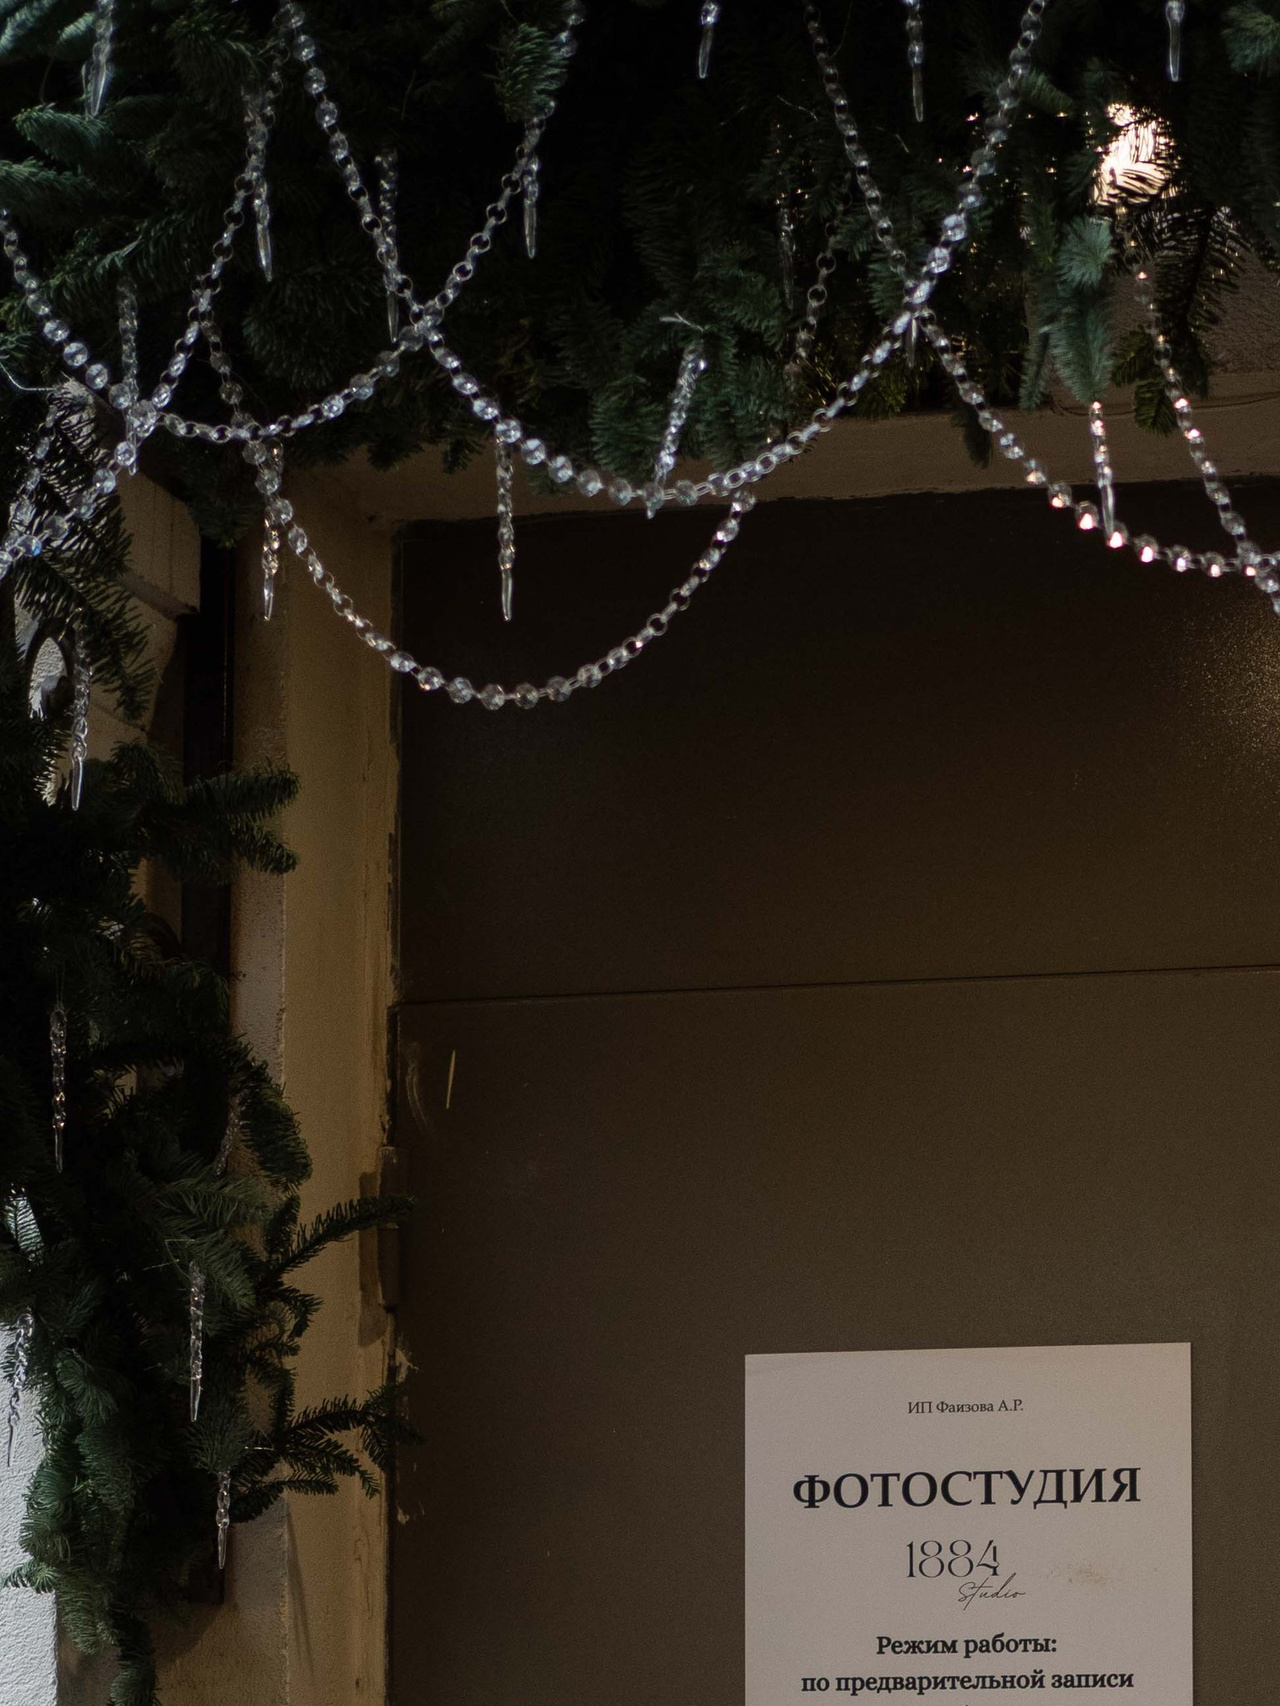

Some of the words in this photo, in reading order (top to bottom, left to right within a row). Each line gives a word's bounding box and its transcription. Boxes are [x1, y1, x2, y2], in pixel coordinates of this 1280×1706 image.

[907, 1401, 933, 1414] ИП
[936, 1400, 994, 1414] Фаизова
[997, 1399, 1023, 1412] А.Р.
[792, 1466, 1142, 1509] ФОТОСТУДИЯ
[906, 1539, 1000, 1578] 1884
[958, 1572, 1026, 1610] Studio
[875, 1635, 958, 1655] Режим
[963, 1632, 1057, 1658] работы:
[801, 1673, 830, 1692] по
[835, 1669, 1046, 1695] предварительной
[1051, 1671, 1134, 1689] записи
